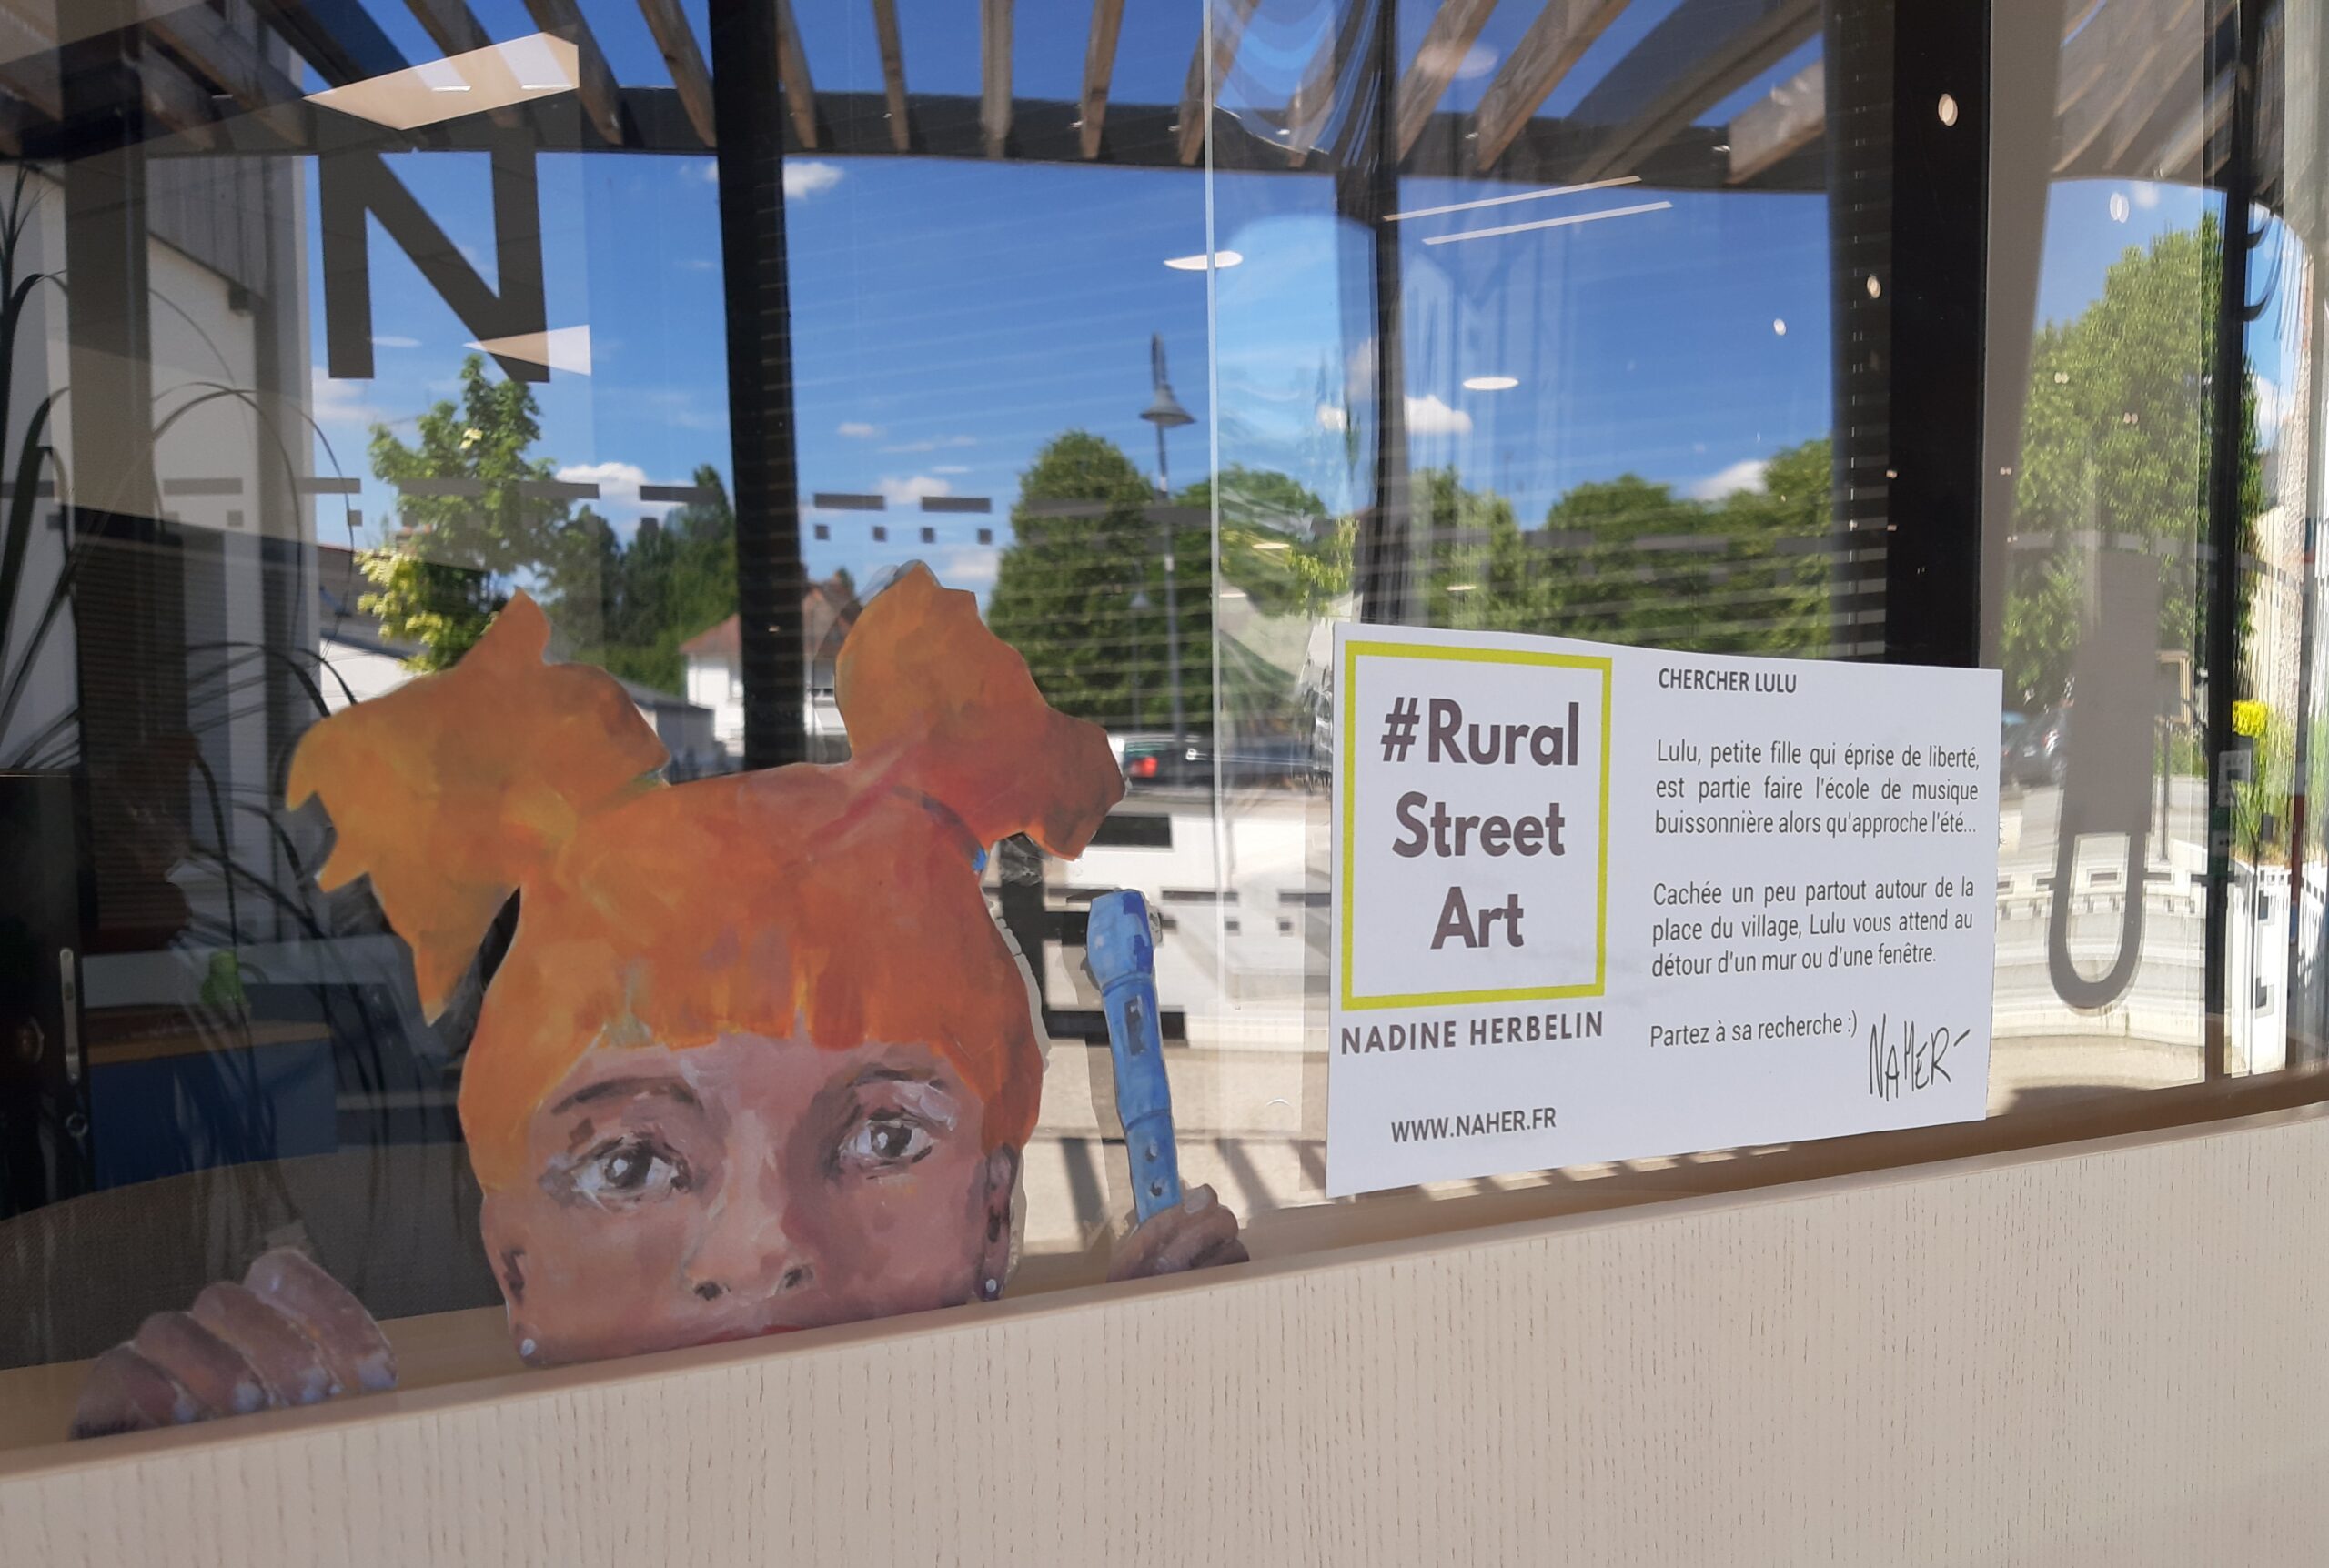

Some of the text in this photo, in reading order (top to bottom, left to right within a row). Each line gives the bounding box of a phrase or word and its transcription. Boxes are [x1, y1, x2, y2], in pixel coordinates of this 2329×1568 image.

[1659, 668, 1796, 693] CHERCHER LULU
[1380, 697, 1579, 766] #Rural
[1658, 739, 1979, 770] Lulu, petite fille qui éprise de liberté,
[1657, 775, 1978, 805] est partie faire l'école de musique
[1392, 791, 1565, 858] Street
[1656, 810, 1773, 833] buissonnière
[1779, 810, 1820, 833] alors
[1827, 811, 1927, 839] qu'approche
[1654, 876, 1973, 908] Cachée un peu partout autour de la
[1430, 885, 1524, 950] Art
[1653, 908, 1972, 947] place du village, Lulu vous attend au
[1652, 942, 1936, 977] détour d'un mur ou d'une fenêtre.
[1342, 1011, 1602, 1055] NADINE HERBELIN
[1651, 1025, 1709, 1047] Partez
[1716, 1020, 1725, 1042] à
[1732, 1024, 1751, 1041] sa
[1759, 1012, 1842, 1039] recherche
[1391, 1107, 1556, 1143] WWW.NAHER.FR
